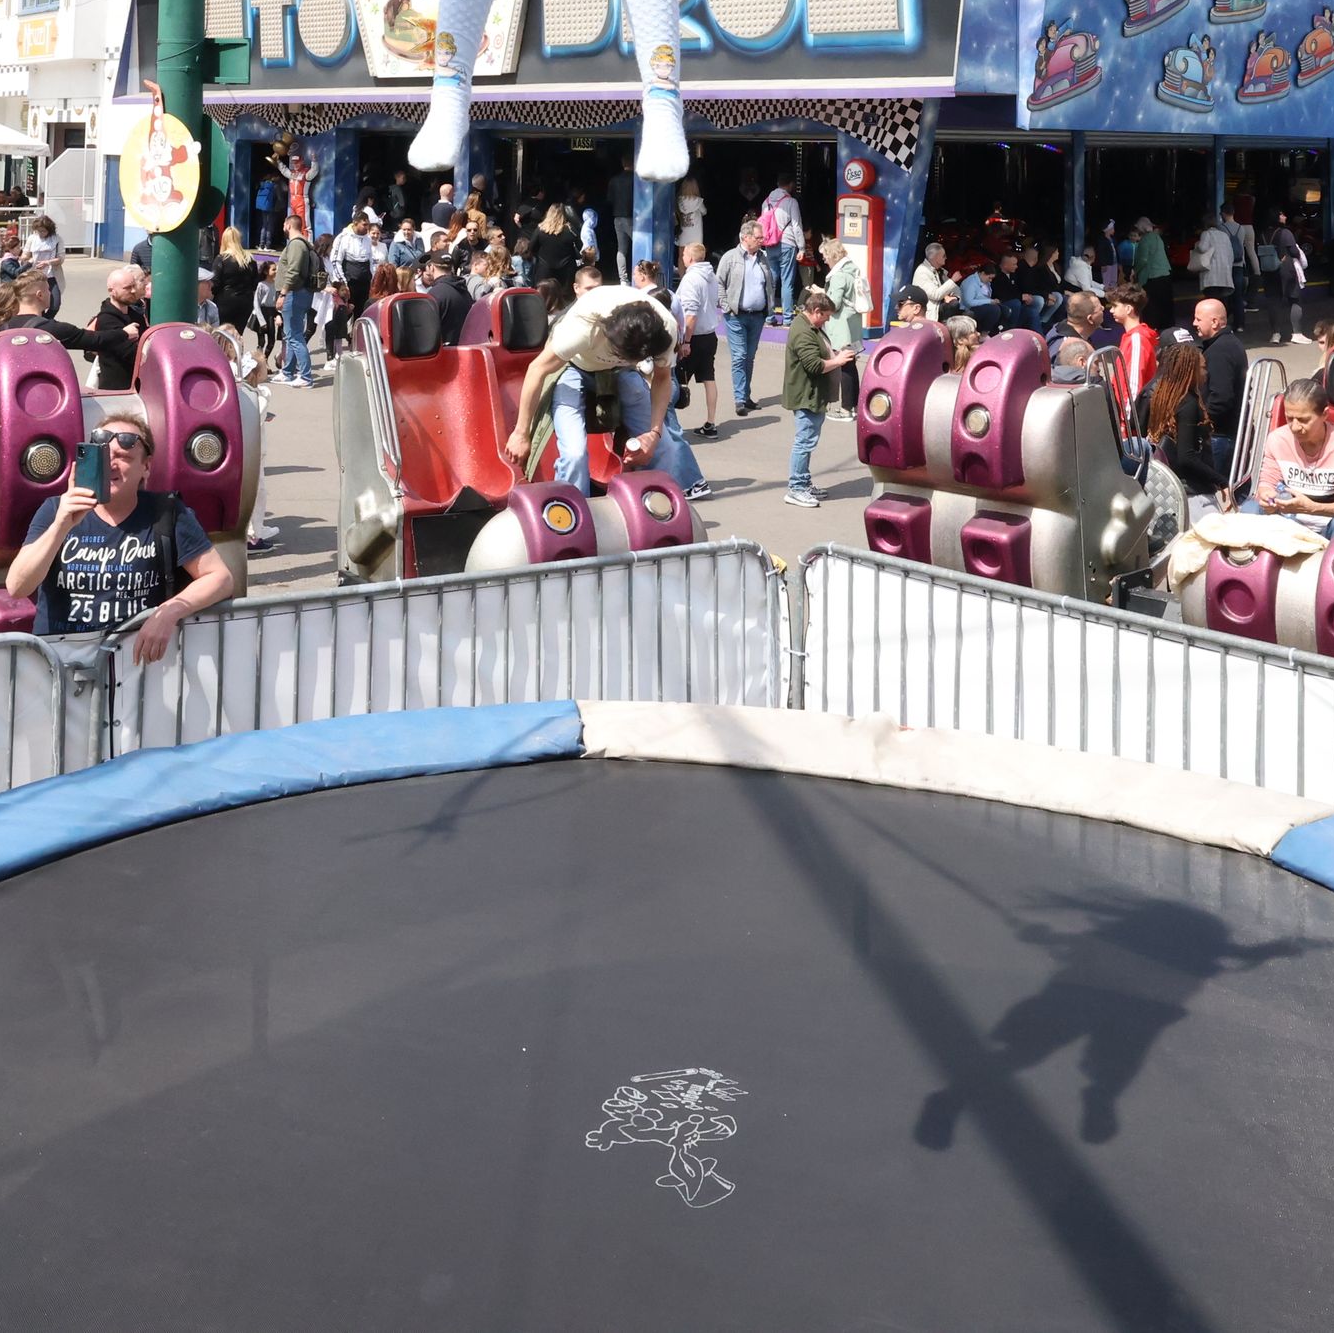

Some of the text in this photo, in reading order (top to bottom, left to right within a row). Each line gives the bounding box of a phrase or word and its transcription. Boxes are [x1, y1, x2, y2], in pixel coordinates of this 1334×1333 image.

[847, 168, 862, 181] Esso
[81, 535, 105, 543] SHORES
[61, 536, 116, 573] Camp
[57, 570, 160, 591] ARCTIC CIRCLE
[67, 599, 94, 623] 25
